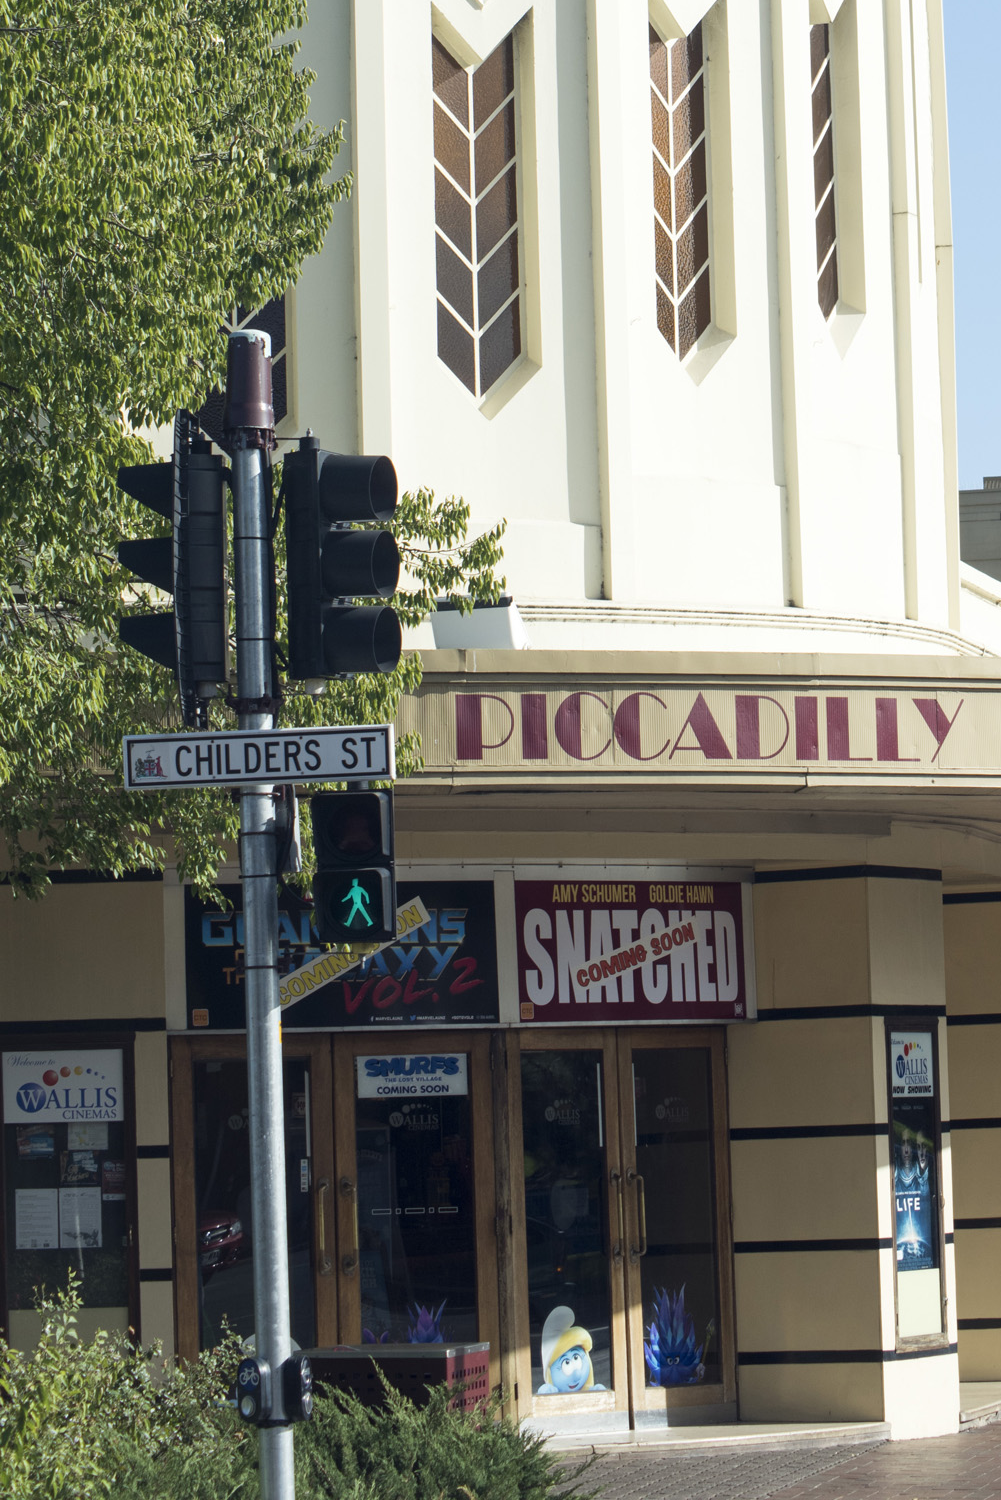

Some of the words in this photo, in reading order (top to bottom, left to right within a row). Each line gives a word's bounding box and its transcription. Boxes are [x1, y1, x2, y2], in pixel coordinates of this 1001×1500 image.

[454, 690, 964, 763] PICCADILLY
[174, 738, 322, 777] CHILDERS
[341, 736, 377, 770] ST
[552, 884, 579, 903] AMY
[582, 884, 636, 903] SCHUMER
[649, 884, 684, 904] GOLDIE
[686, 885, 714, 904] HAWN
[650, 922, 695, 956] SOON
[523, 908, 739, 1006] SNATCHED
[576, 944, 648, 988] COMING
[342, 968, 440, 1014] VOL.
[448, 956, 486, 996] 2
[7, 1052, 47, 1067] Welcome
[47, 1058, 56, 1066] to
[364, 1056, 460, 1078] SMURFS
[896, 1055, 928, 1078] WALLIS
[376, 1085, 418, 1095] COMING
[420, 1084, 450, 1094] SOON
[892, 1085, 906, 1094] NOW
[907, 1085, 932, 1094] SHOWING
[904, 1074, 929, 1086] CINEMAS
[16, 1083, 118, 1113] WALLIS
[62, 1108, 117, 1120] CINEMAS
[389, 1112, 439, 1128] WALLIS
[896, 1197, 921, 1212] LIFE
